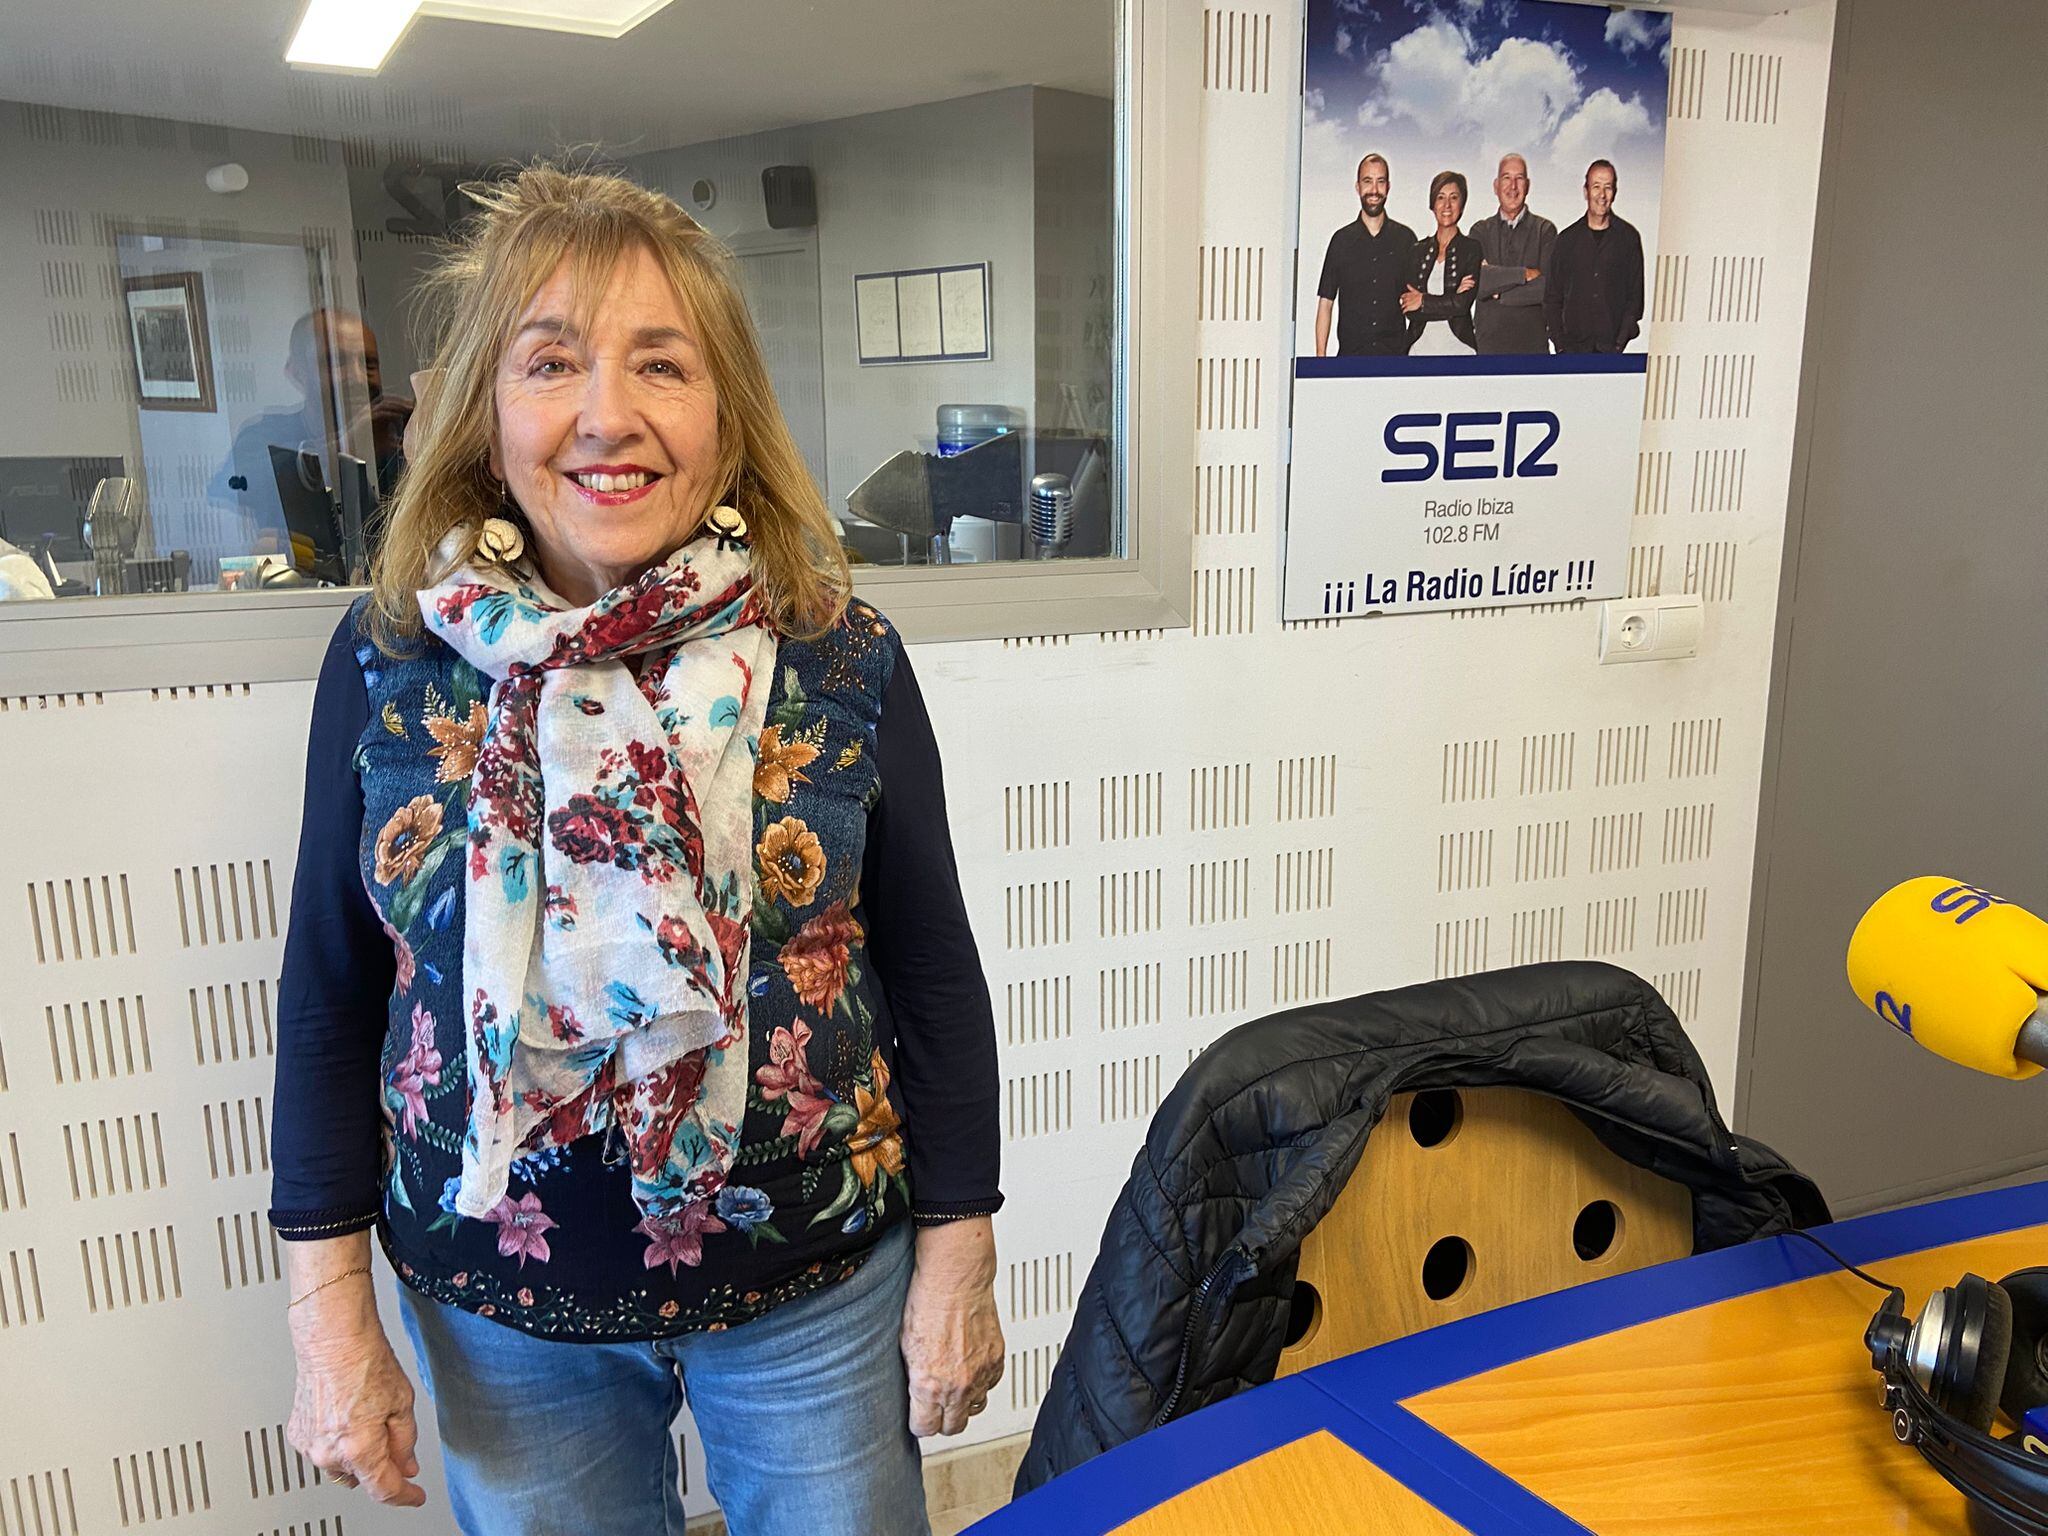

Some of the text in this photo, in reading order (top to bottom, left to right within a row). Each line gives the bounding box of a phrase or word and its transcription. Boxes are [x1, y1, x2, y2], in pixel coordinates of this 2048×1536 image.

[1381, 411, 1561, 483] SER
[1424, 498, 1514, 518] Radio Ibiza
[1423, 523, 1500, 544] 102.8 FM
[1365, 573, 1397, 605] La
[1406, 568, 1482, 602] Radio
[1491, 562, 1559, 598] Líder
